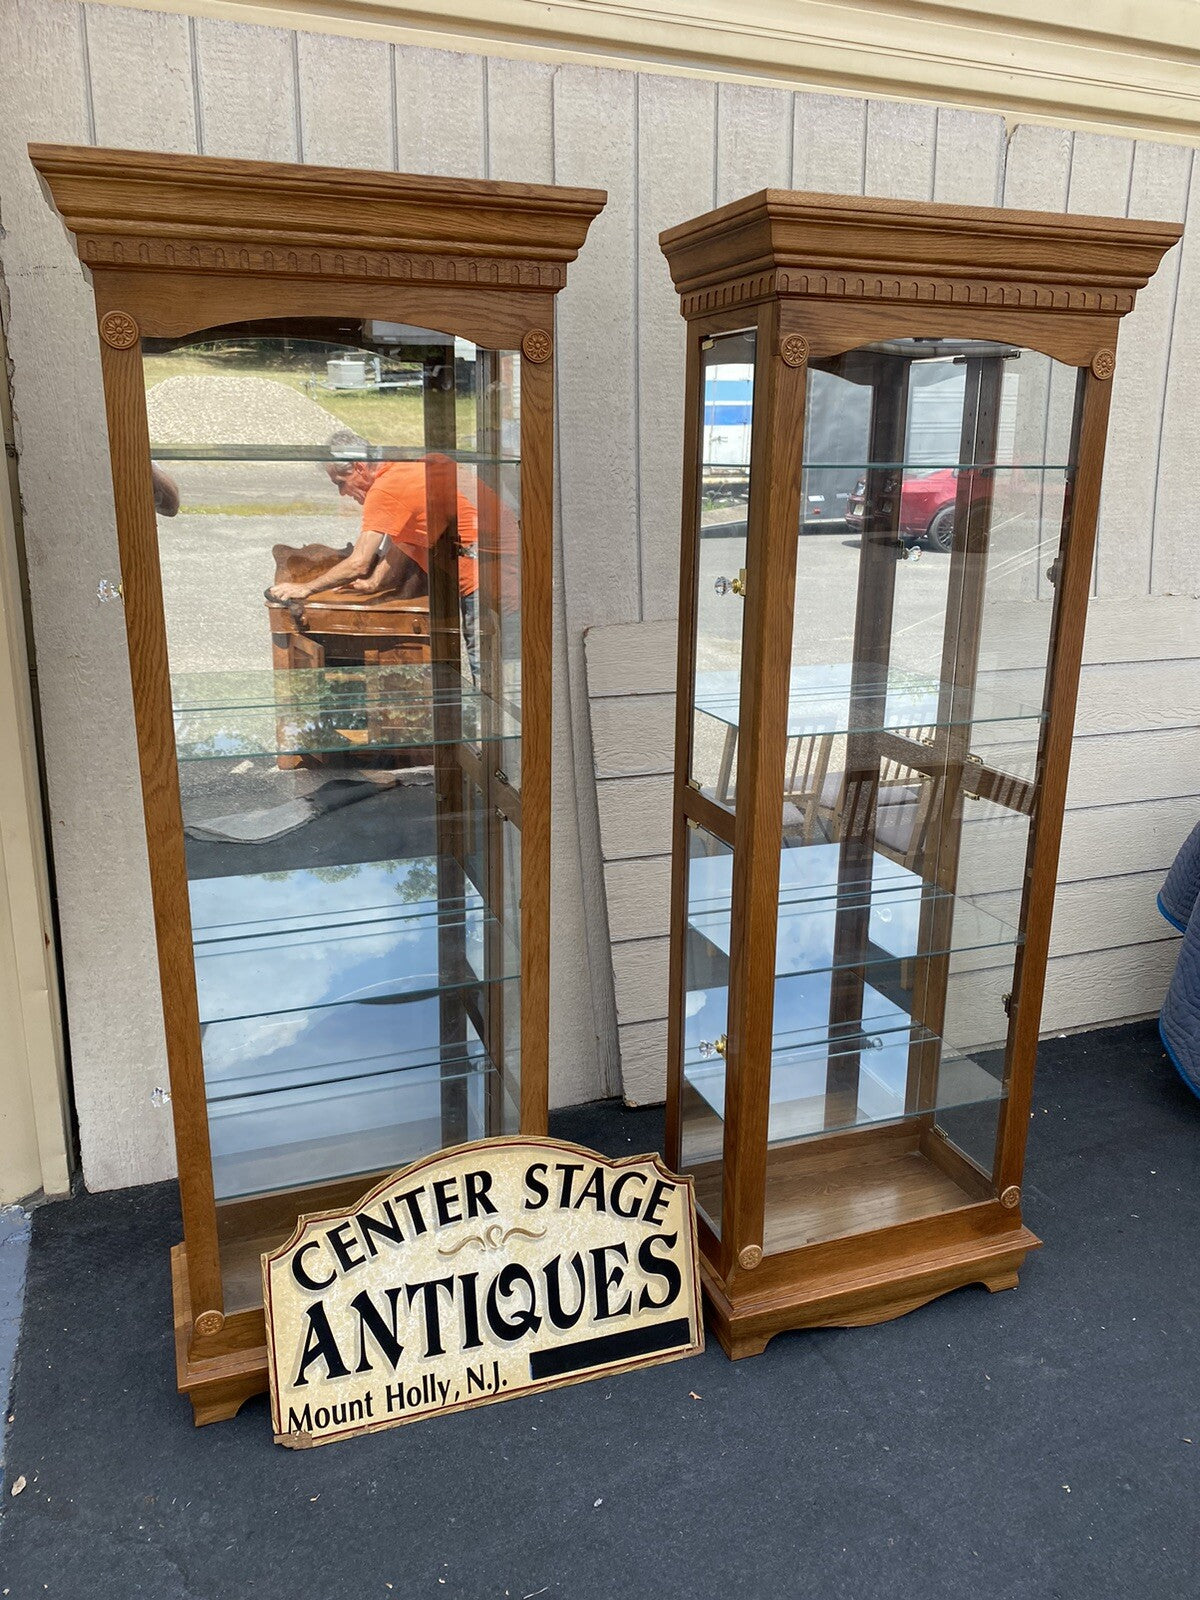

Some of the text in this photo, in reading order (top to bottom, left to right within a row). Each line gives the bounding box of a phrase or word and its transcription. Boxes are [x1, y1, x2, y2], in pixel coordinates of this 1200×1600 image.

[291, 1163, 676, 1291] CENTER STAGE
[292, 1231, 682, 1388] ANTIQUES
[287, 1361, 508, 1434] Mount Holly, N.J.
